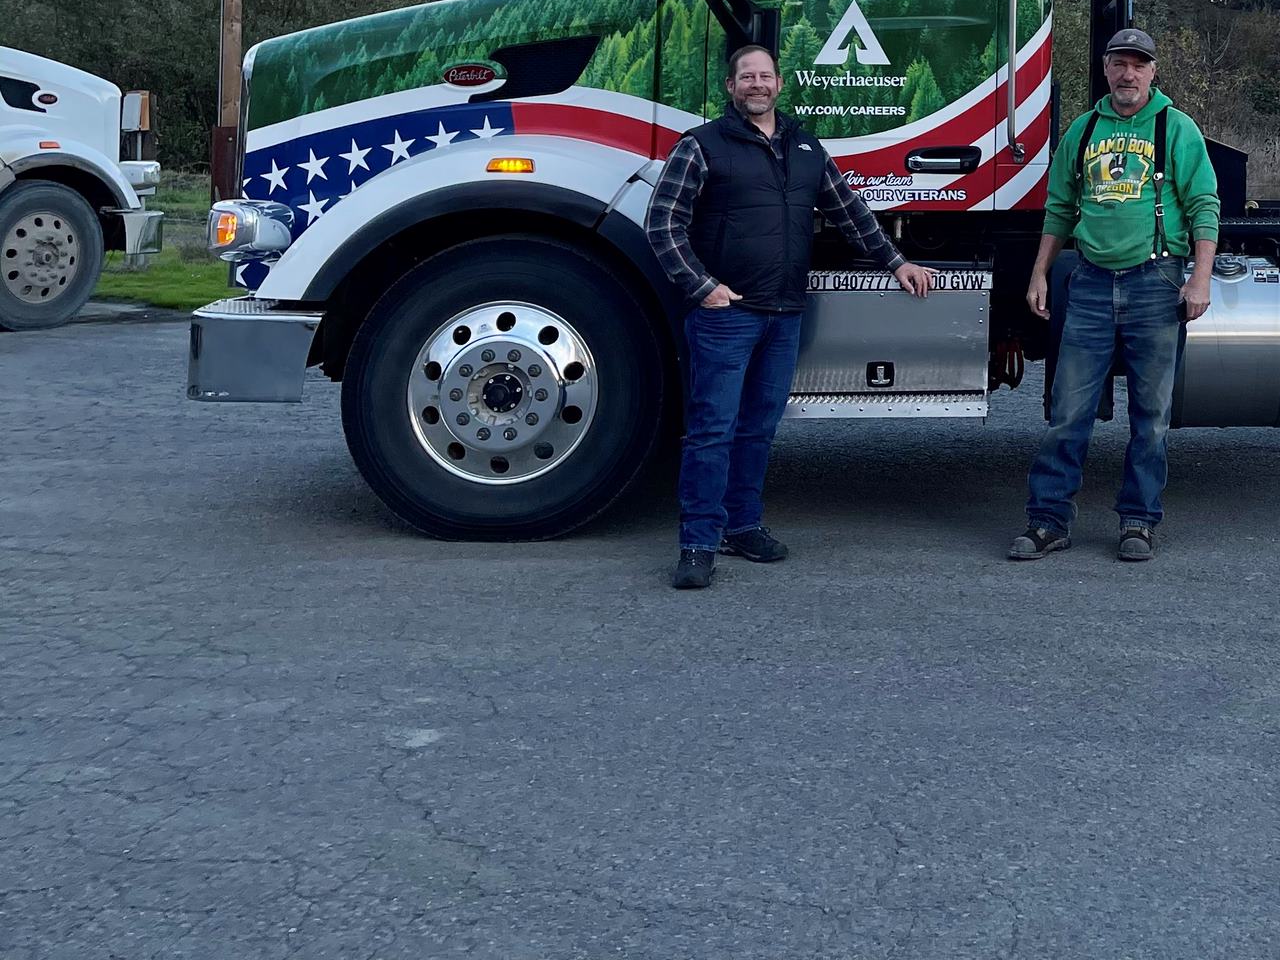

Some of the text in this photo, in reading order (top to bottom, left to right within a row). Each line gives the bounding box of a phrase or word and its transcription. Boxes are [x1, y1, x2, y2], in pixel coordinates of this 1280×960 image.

[448, 69, 491, 82] Peterbilt
[795, 70, 907, 90] Weyerhaeuser
[795, 105, 906, 116] WY.COM/CAREERS
[1128, 138, 1155, 160] BOW
[866, 175, 885, 186] our
[885, 172, 912, 186] team
[863, 189, 894, 201] OUR
[894, 189, 967, 201] VETERANS
[806, 275, 830, 290] OT
[832, 275, 892, 290] 0407777
[951, 274, 984, 290] GVW
